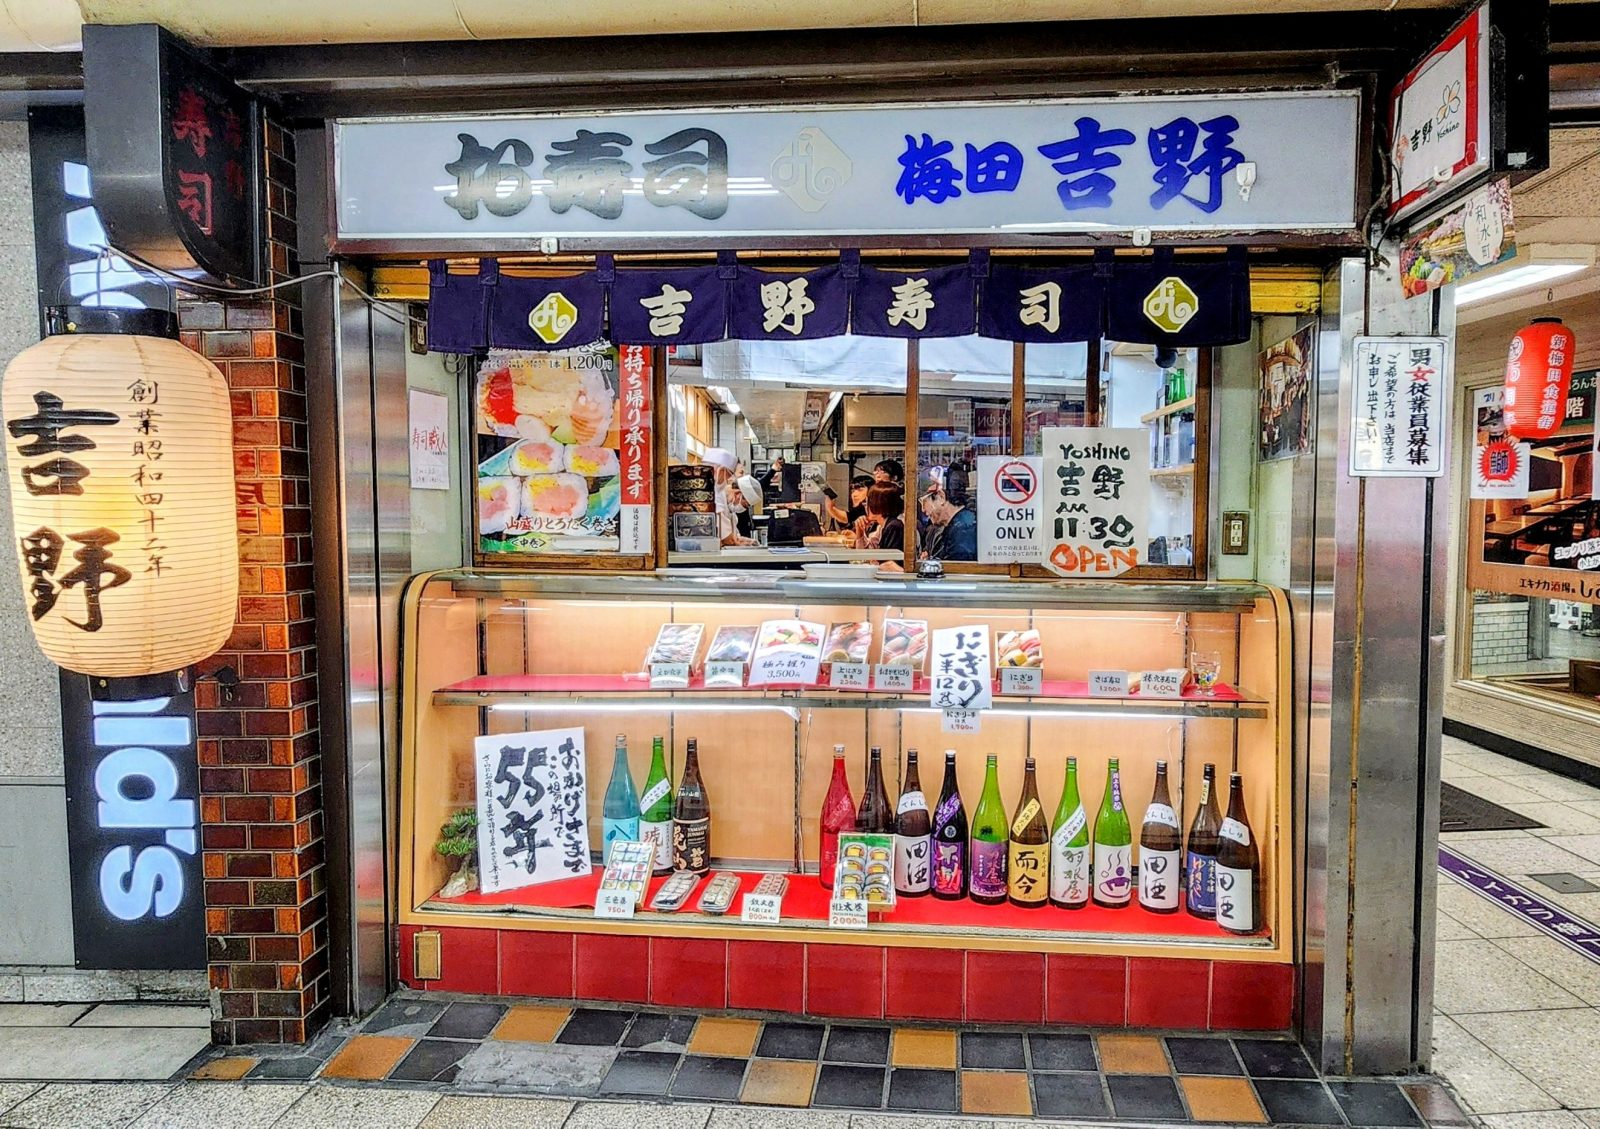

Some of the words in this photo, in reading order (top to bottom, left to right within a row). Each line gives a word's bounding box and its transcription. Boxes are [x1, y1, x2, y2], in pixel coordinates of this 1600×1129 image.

[1410, 118, 1433, 152] 吉野
[639, 277, 1062, 338] 吉野寿司
[565, 355, 614, 372] 1,200円
[1537, 333, 1567, 430] 新梅田食道街
[1404, 348, 1435, 465] 男女従業員募集
[127, 378, 173, 578] 創業昭和四十二年
[1056, 461, 1125, 500] 吉野
[6, 390, 132, 632] 吉野
[996, 508, 1034, 521] CASH
[996, 527, 1035, 539] ONLY
[1049, 543, 1141, 573] OPEN
[953, 631, 987, 709] にぎり
[558, 736, 588, 873] おかげさまで
[905, 840, 928, 886] 田酒
[1014, 850, 1039, 894] 而今
